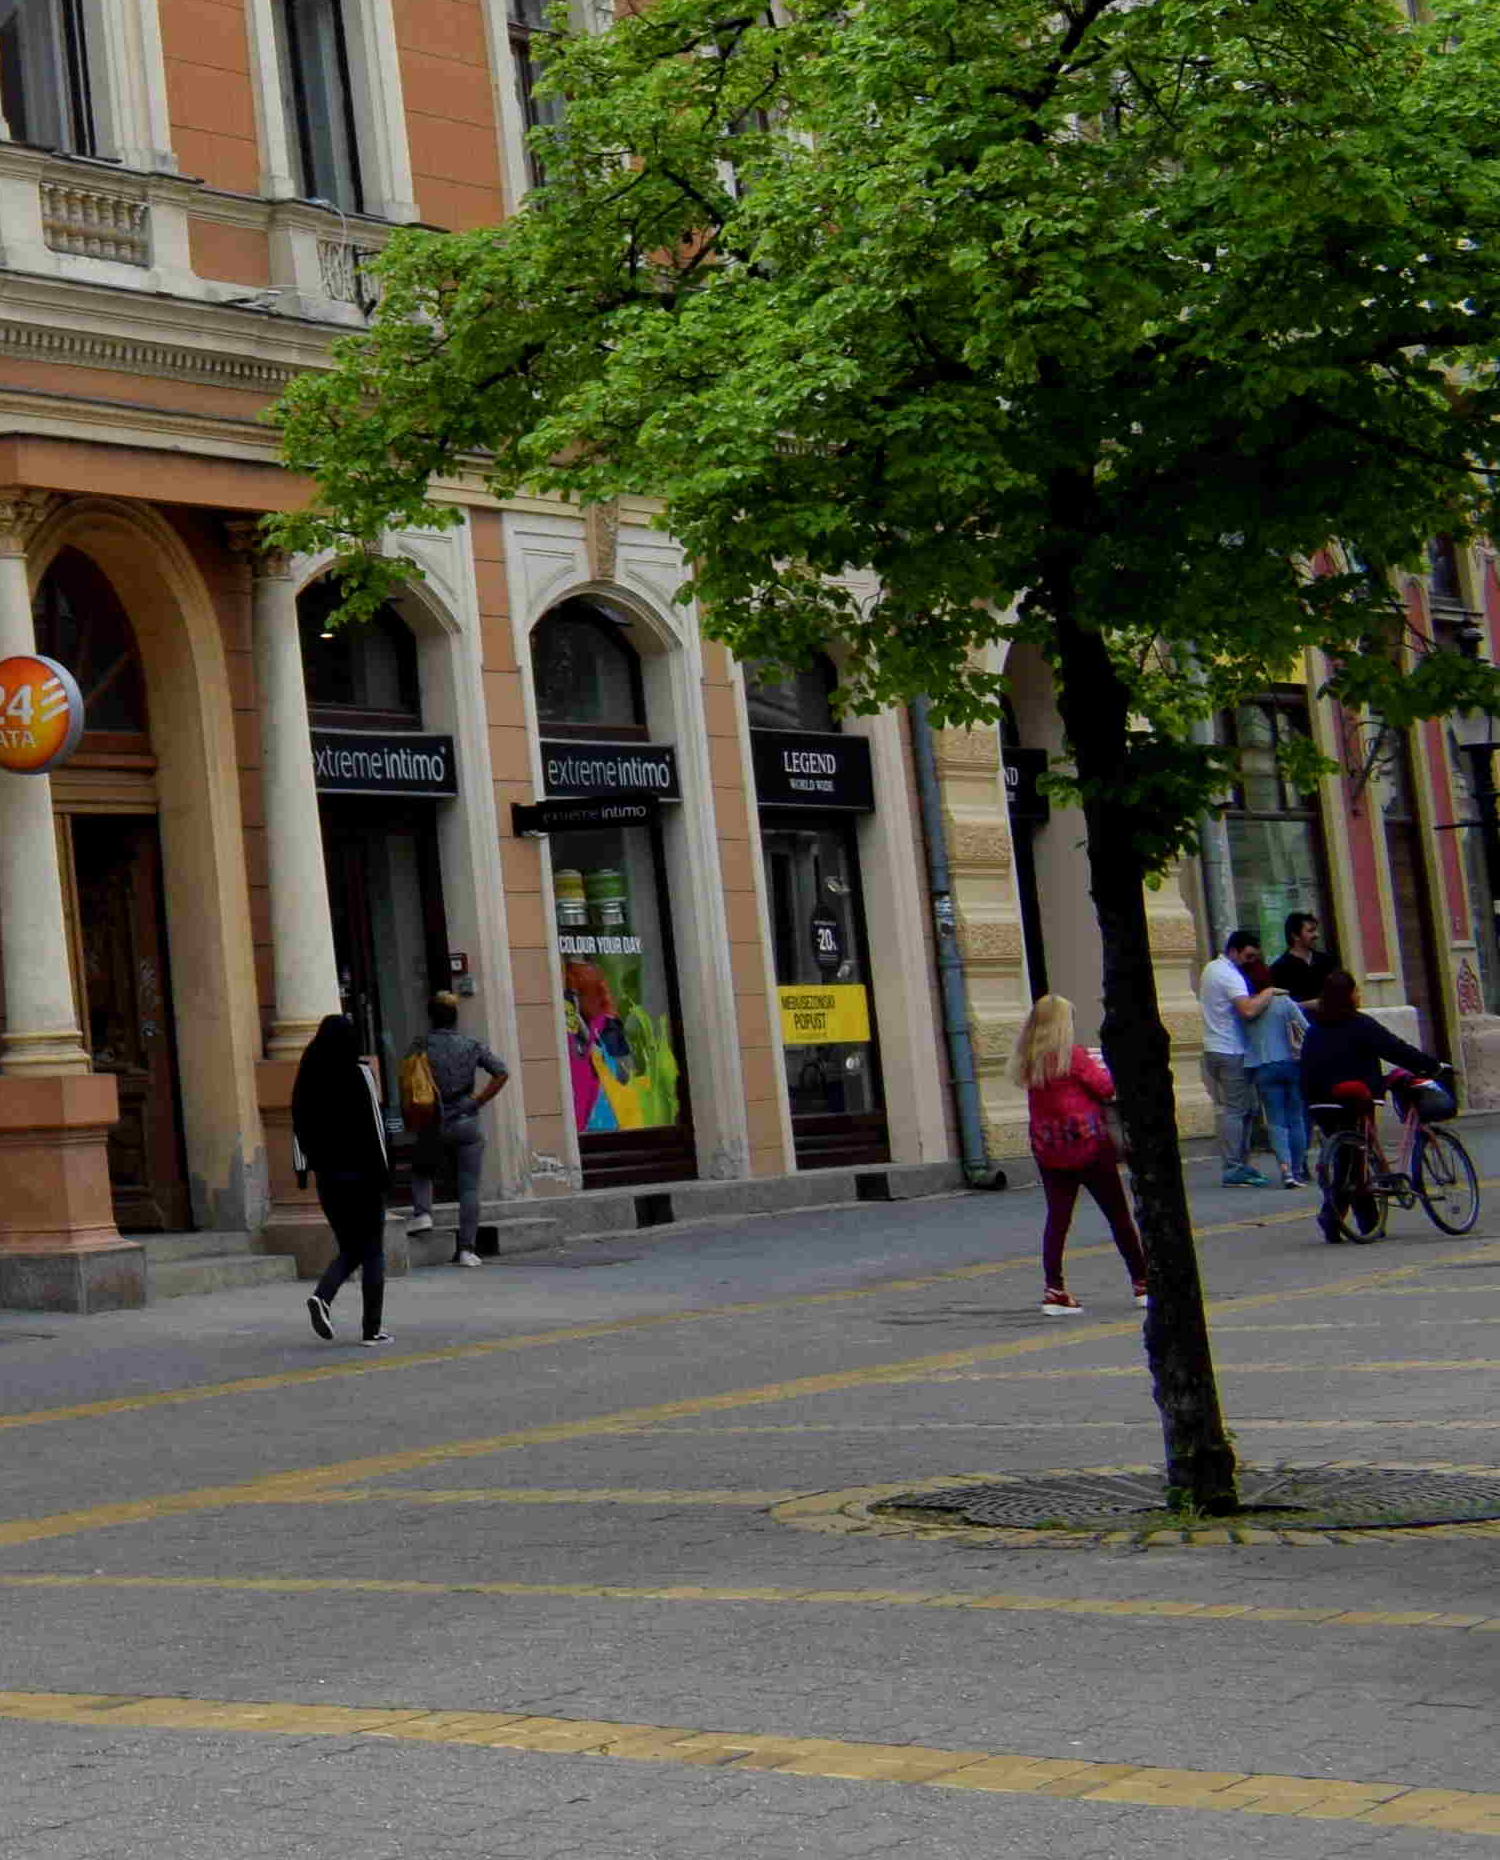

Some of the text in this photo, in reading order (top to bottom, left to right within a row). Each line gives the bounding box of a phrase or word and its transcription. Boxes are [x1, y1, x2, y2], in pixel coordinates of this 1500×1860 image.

[784, 751, 837, 775] LEGEND
[602, 803, 647, 821] intimo
[557, 935, 596, 954] COLOUR
[597, 936, 621, 954] YOUR
